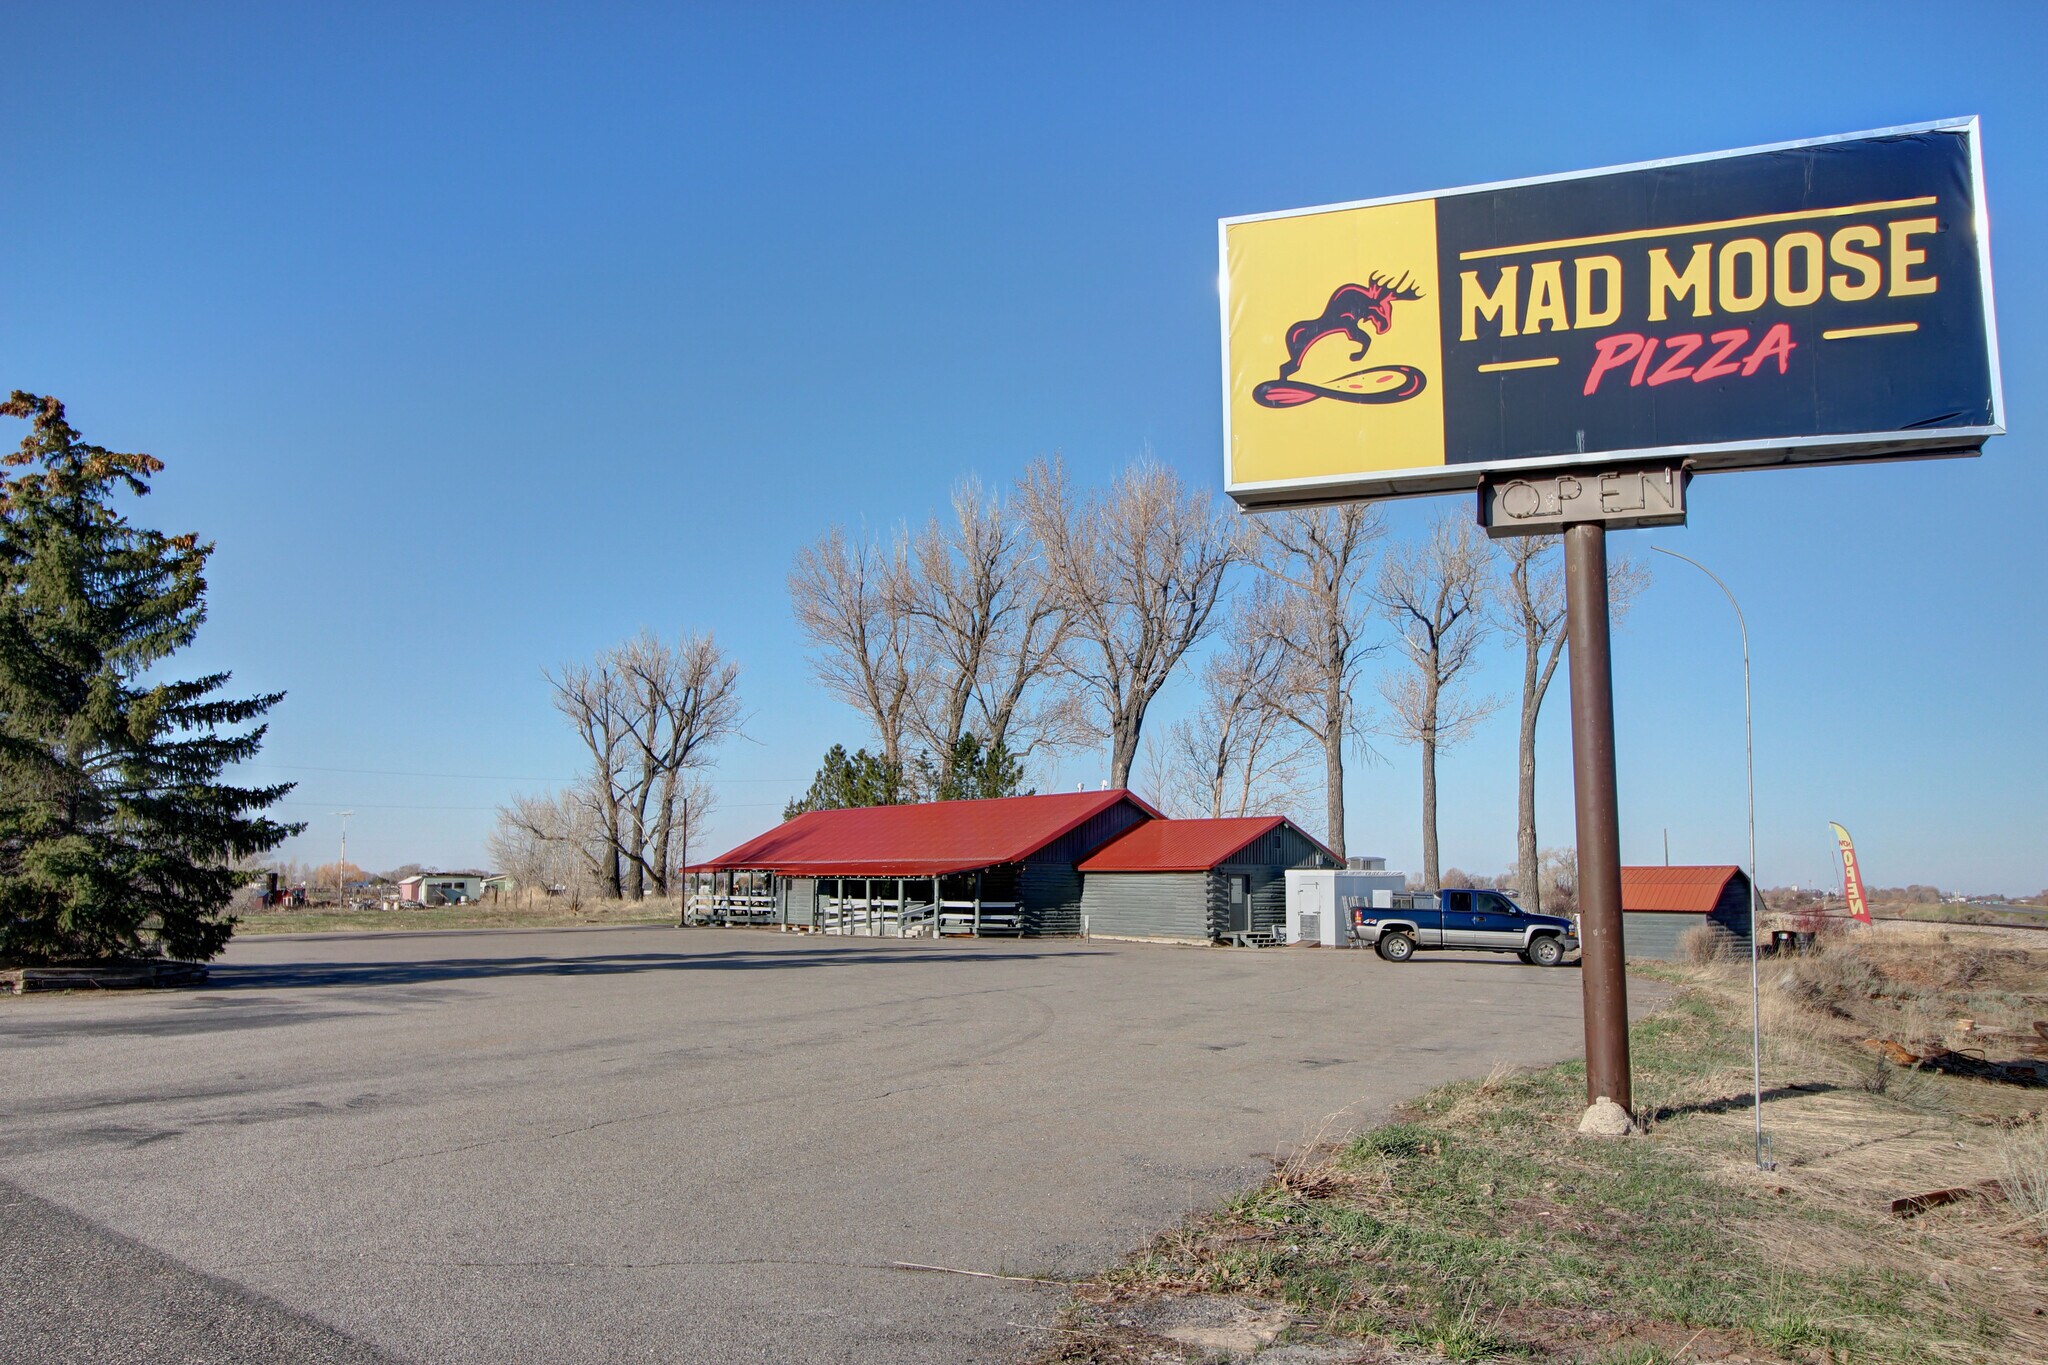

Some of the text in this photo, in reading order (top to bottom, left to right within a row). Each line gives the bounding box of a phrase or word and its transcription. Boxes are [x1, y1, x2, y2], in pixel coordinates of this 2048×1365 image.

[1459, 217, 1937, 341] MAD MOOSE
[1583, 322, 1797, 396] PIZZA
[1500, 467, 1674, 519] OPEN
